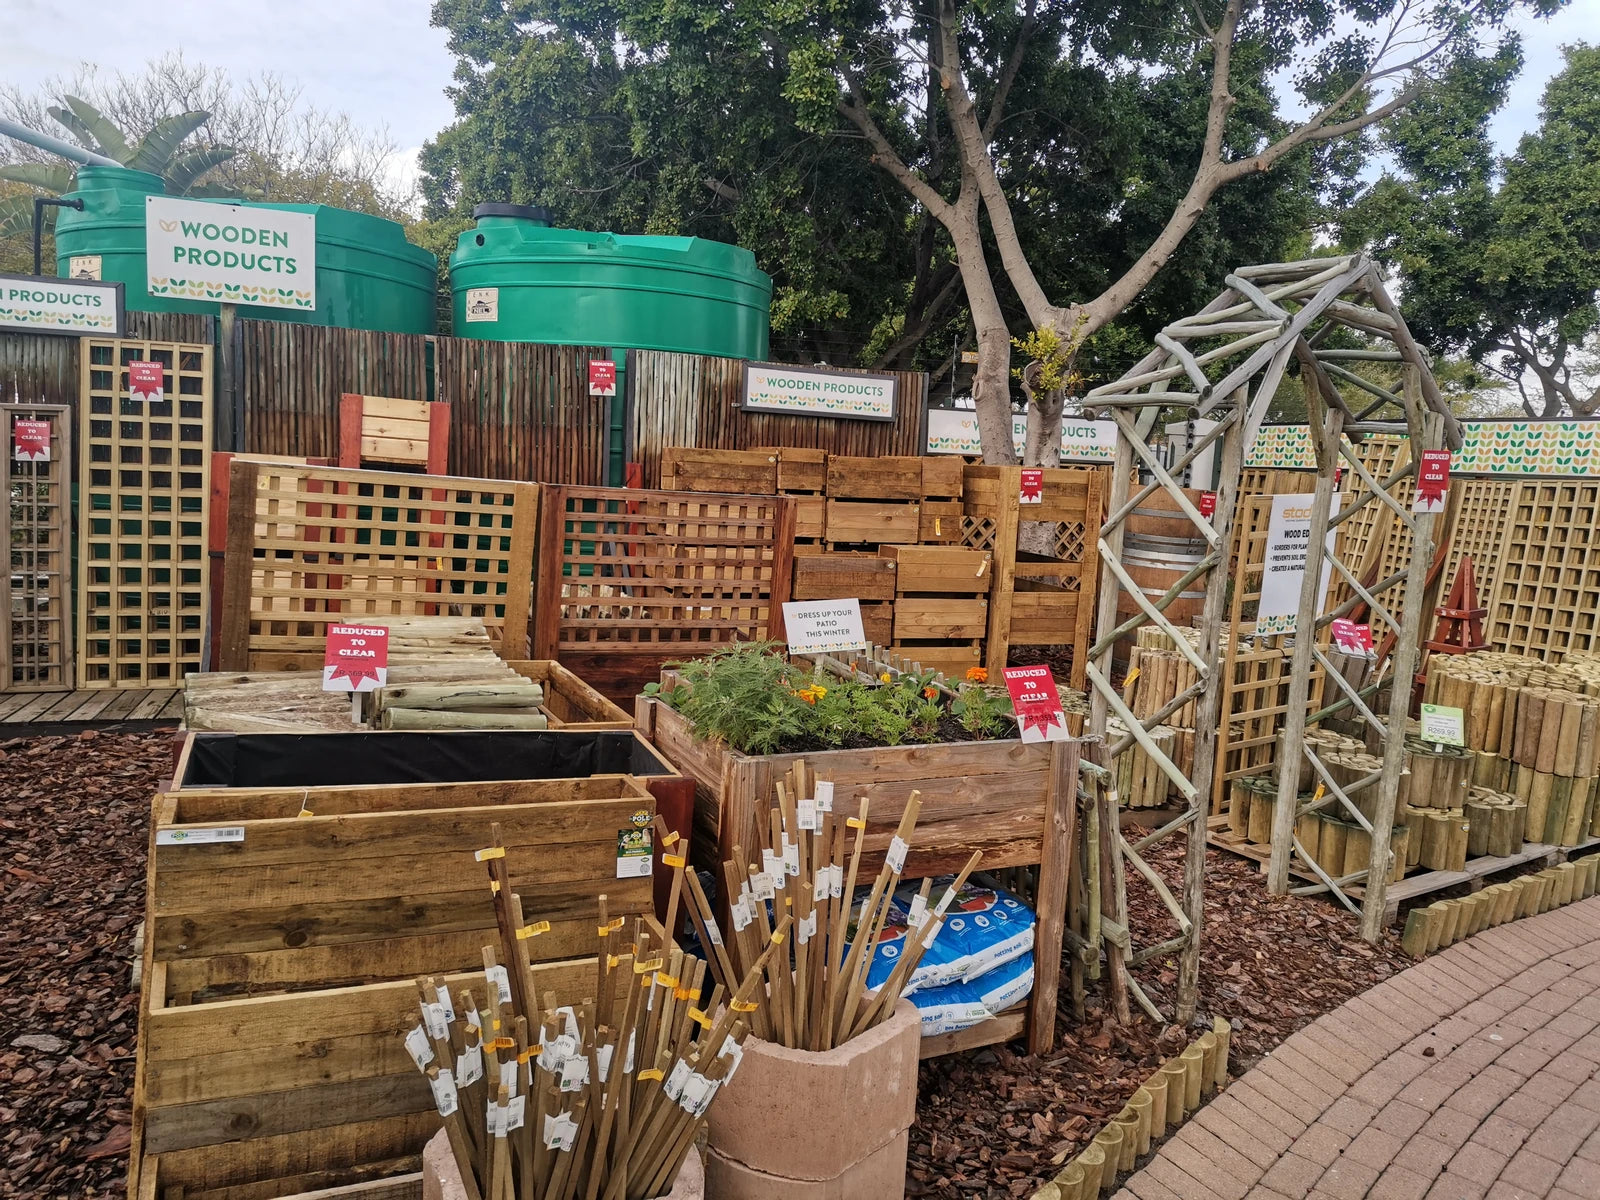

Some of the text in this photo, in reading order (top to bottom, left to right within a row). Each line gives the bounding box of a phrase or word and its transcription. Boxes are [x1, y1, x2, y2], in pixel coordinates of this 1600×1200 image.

[180, 221, 288, 248] WOODEN
[174, 246, 297, 274] PRODUCTS
[9, 289, 102, 307] PRODUCTS
[767, 377, 883, 396] WOODEN PRODUCTS
[1062, 427, 1096, 439] DUCTS
[1425, 473, 1444, 481] CLEAR
[1284, 530, 1301, 538] WOOD
[798, 611, 820, 619] DRESS
[833, 609, 853, 617] YOUR
[332, 627, 386, 636] REDUCED
[338, 648, 376, 657] CLEAR
[1005, 668, 1047, 679] REDUCED
[1020, 692, 1049, 702] CLEAR
